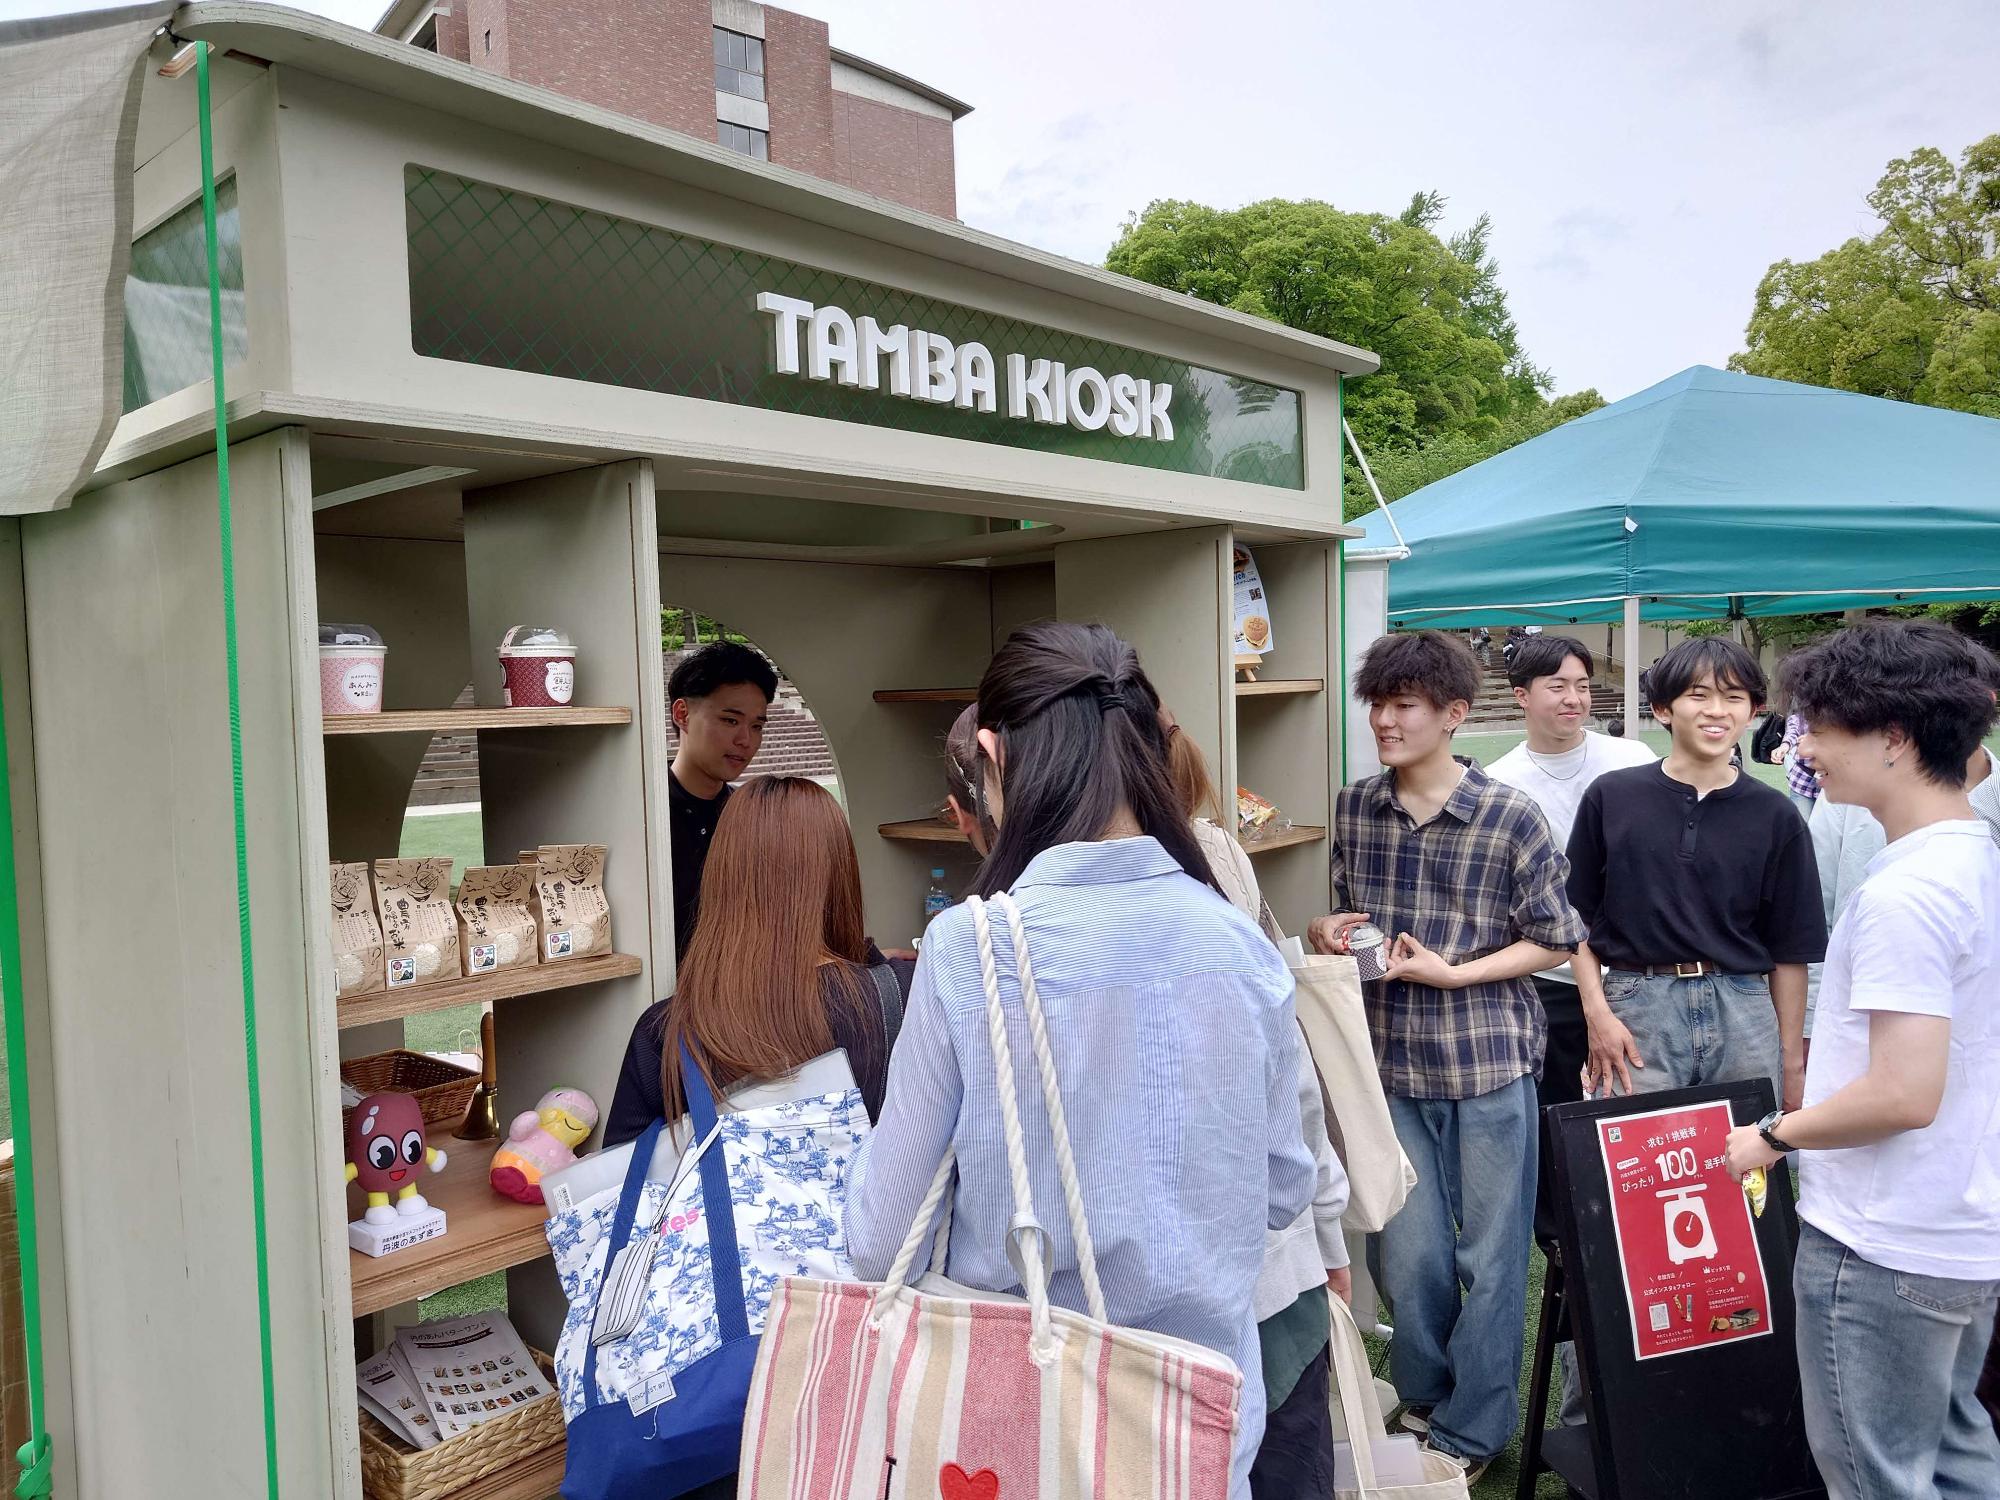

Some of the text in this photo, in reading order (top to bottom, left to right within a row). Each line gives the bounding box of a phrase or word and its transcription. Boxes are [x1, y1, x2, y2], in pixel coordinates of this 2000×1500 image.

[756, 290, 1175, 442] TAMBA KIOSK
[1654, 1146, 1698, 1182] 100
[381, 1227, 443, 1254] 丹波のあずきー
